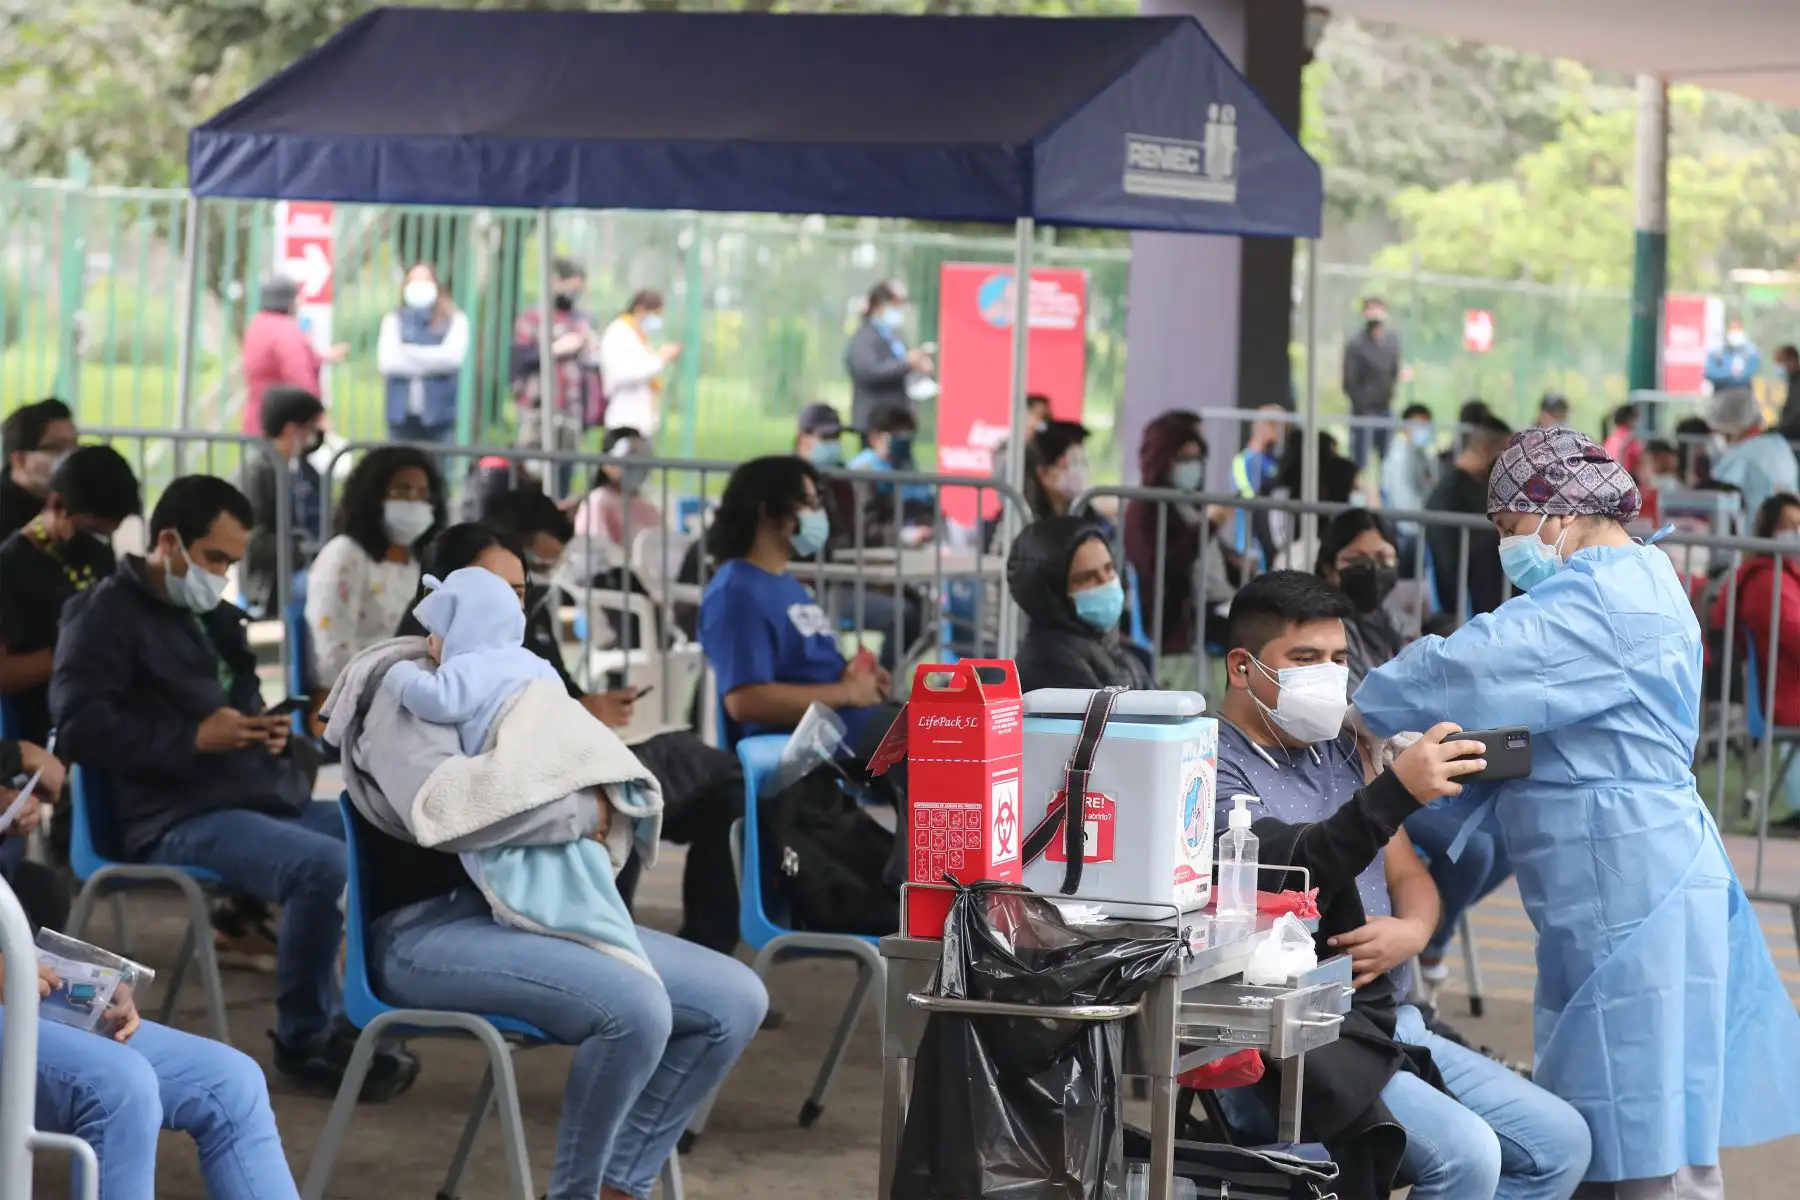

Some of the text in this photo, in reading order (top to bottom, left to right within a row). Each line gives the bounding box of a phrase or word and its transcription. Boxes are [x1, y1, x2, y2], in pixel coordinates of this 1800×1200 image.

[918, 714, 963, 729] LifePack
[964, 717, 977, 728] 5L
[1085, 796, 1105, 809] RE!
